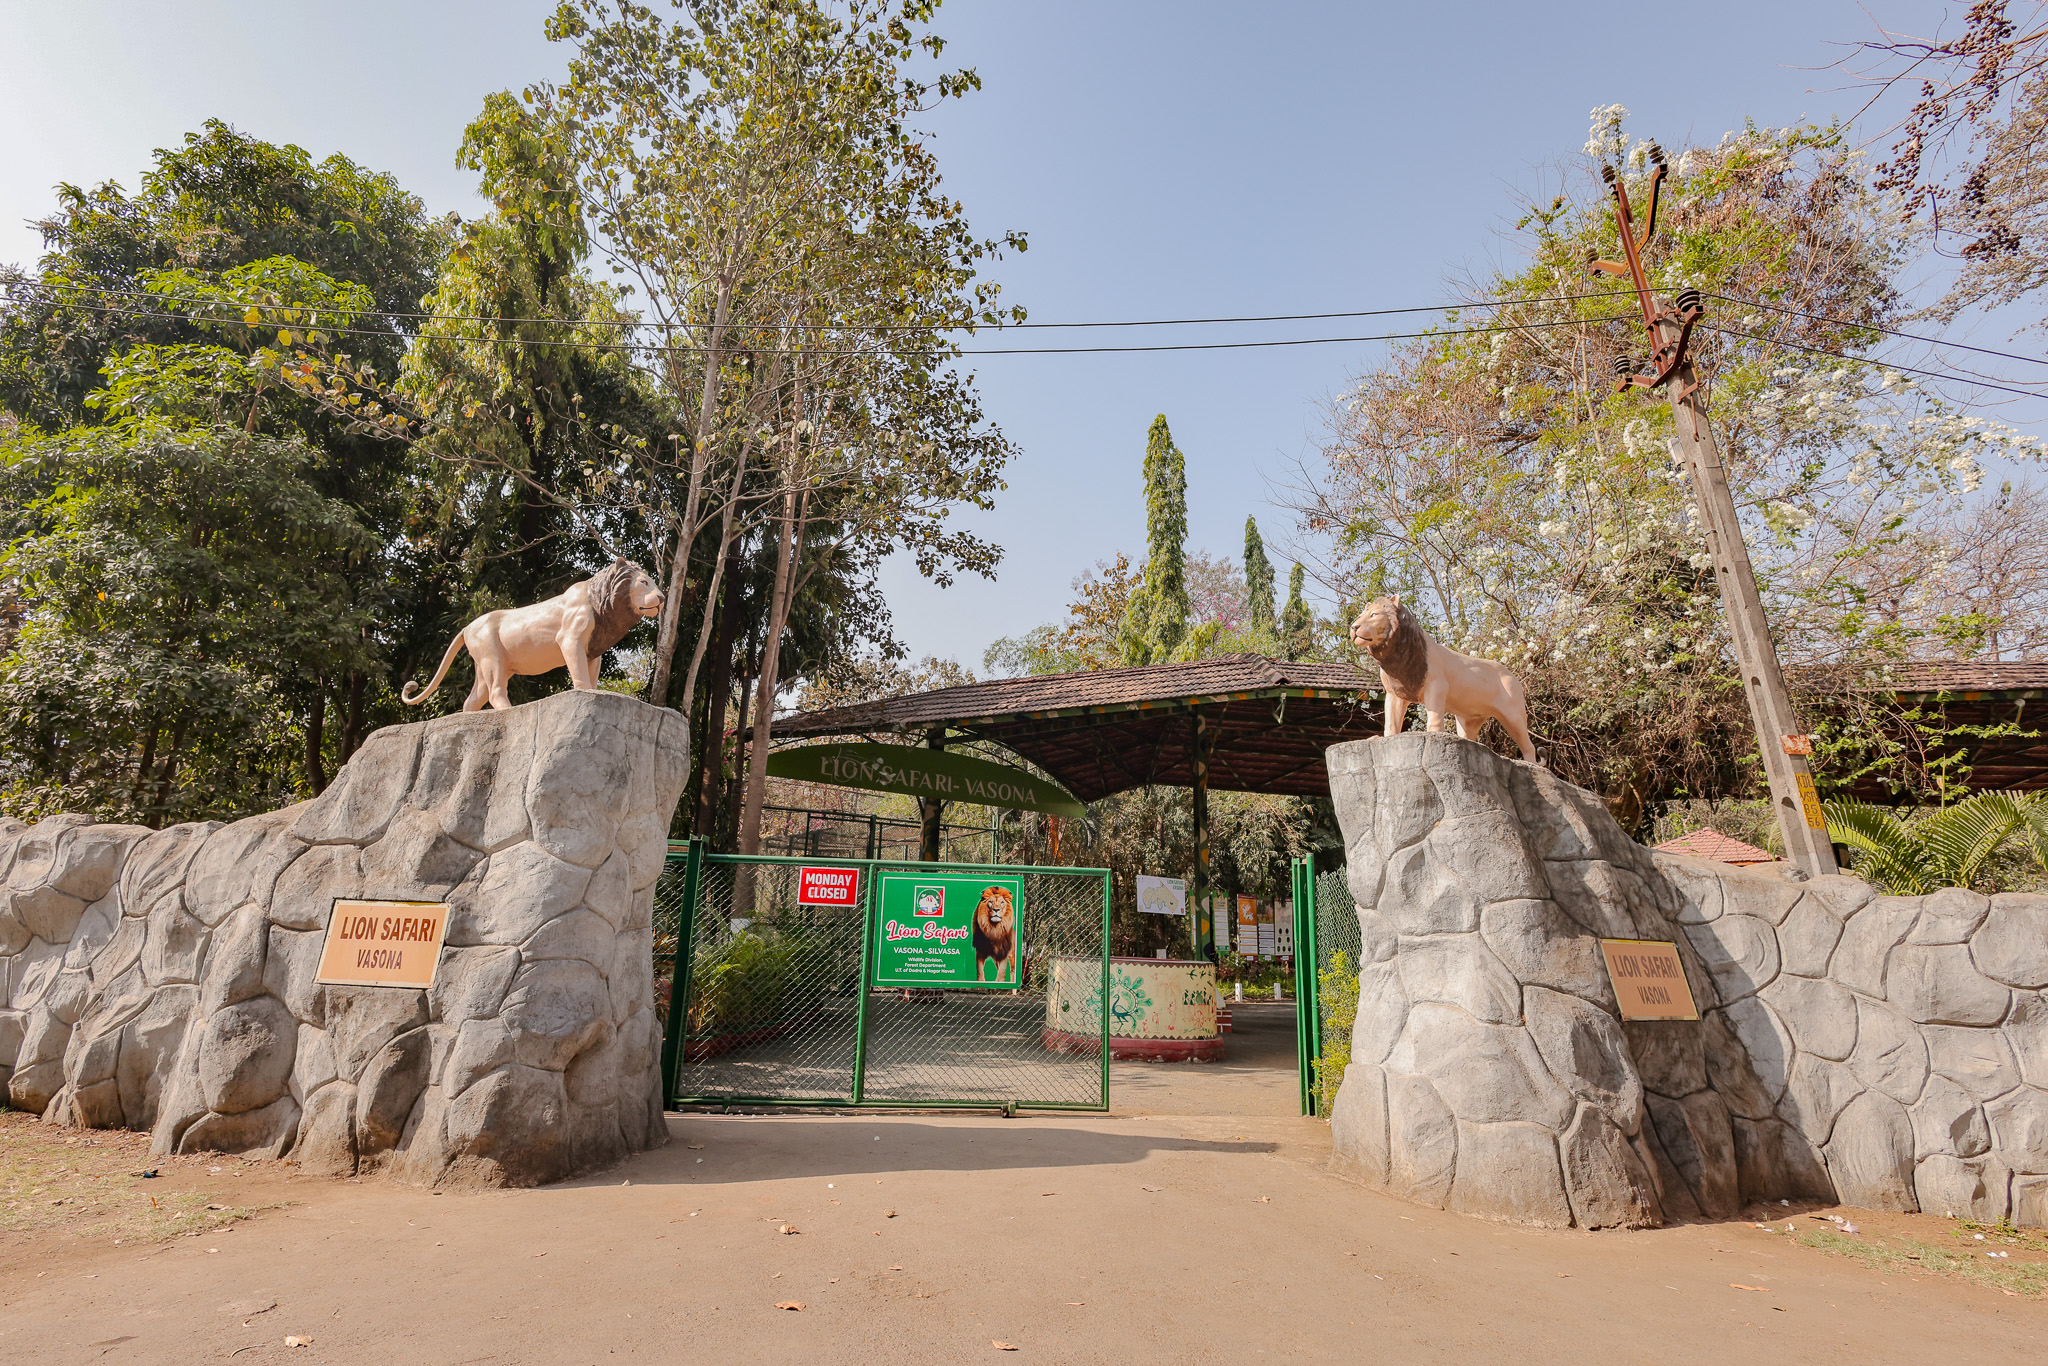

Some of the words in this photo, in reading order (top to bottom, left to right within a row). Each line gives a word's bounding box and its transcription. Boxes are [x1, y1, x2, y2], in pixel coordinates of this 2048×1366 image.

[821, 757, 874, 780] LION
[964, 778, 1037, 804] VASONA
[1808, 816, 1820, 827] 56
[805, 873, 852, 886] MONDAY
[808, 887, 847, 899] CLOSED
[340, 916, 378, 940] LION
[381, 917, 436, 941] SAFARI
[886, 920, 922, 941] Lion
[923, 921, 969, 945] Safari
[357, 949, 402, 969] VASONA
[1613, 955, 1642, 977] LION
[1641, 956, 1679, 978] SAFARI
[1637, 987, 1672, 1004] VASONA
